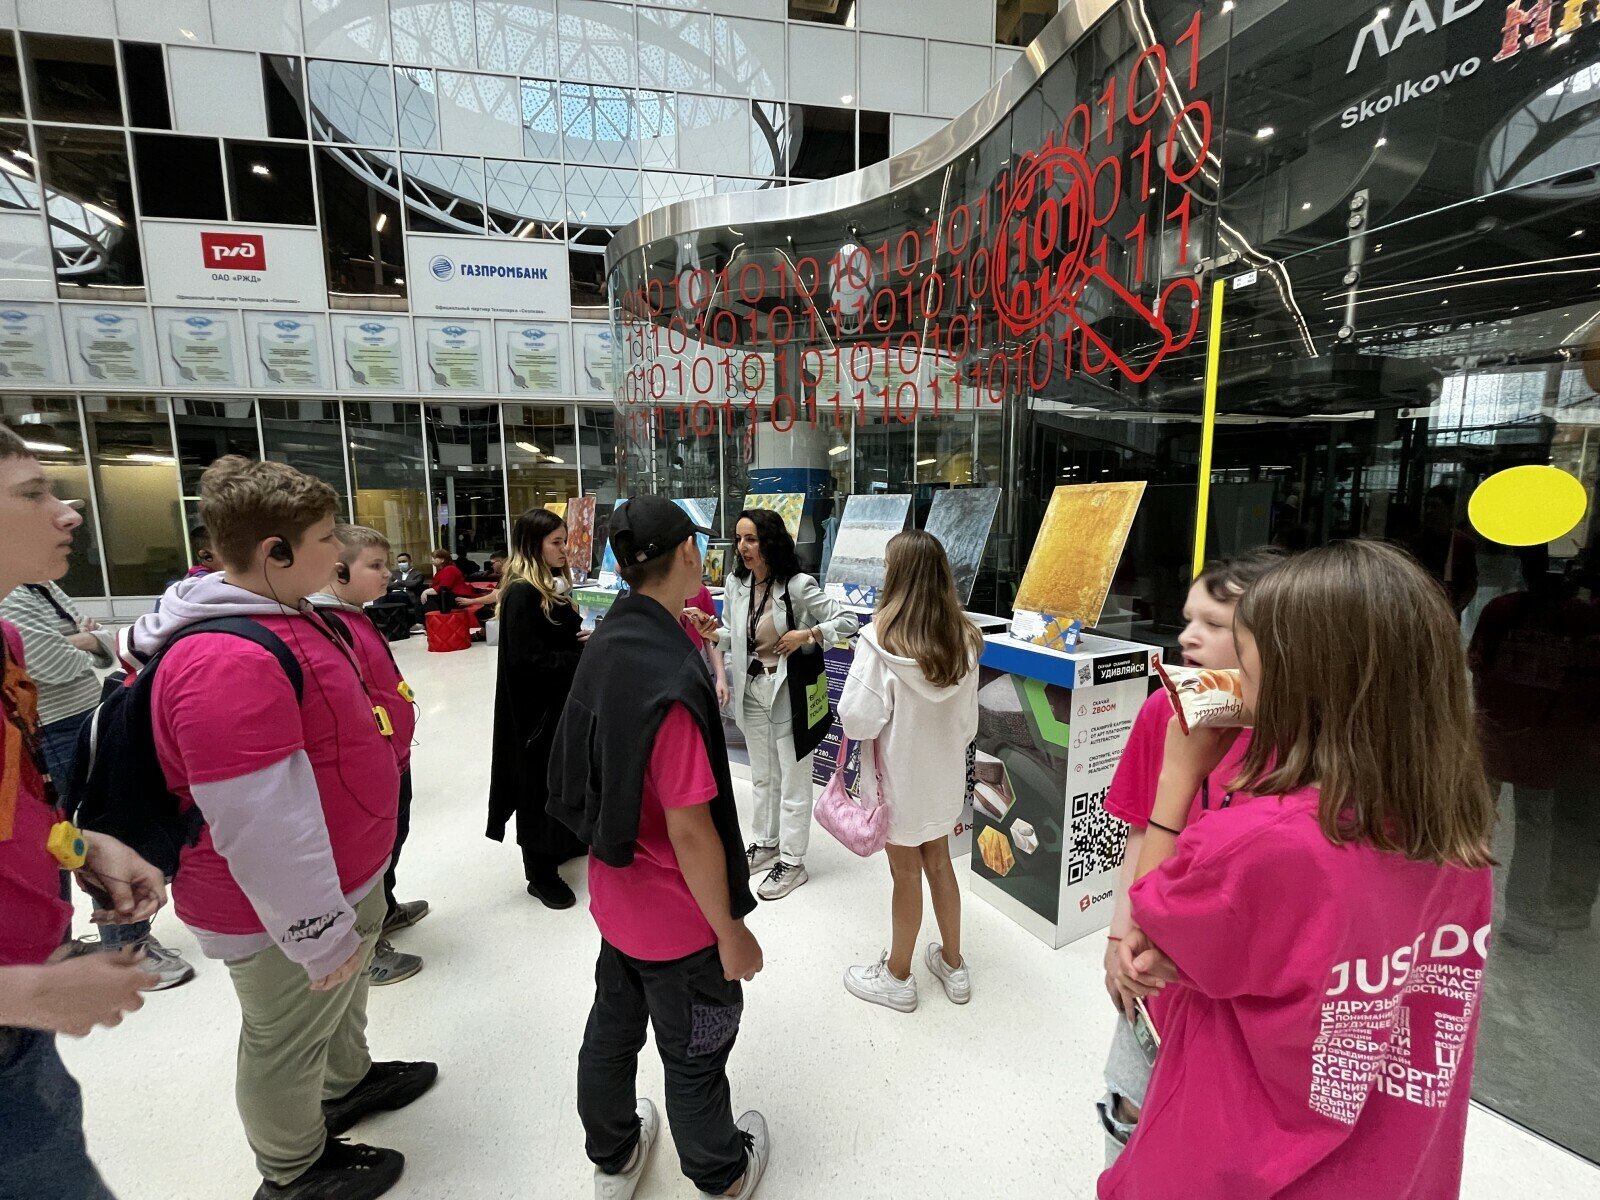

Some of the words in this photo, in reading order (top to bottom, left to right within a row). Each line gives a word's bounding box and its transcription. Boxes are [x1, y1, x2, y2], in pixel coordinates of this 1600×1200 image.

[1340, 56, 1481, 129] Skolkovo
[211, 273, 230, 282] ОАО
[232, 275, 262, 283] «РЖД»
[460, 264, 549, 280] ГАЗПРОМБАНК
[1100, 663, 1146, 680] УДИВЛЯЙСЯ
[1092, 698, 1110, 706] СКАЧАЙ
[1092, 703, 1116, 715] ZBOOM
[1090, 722, 1113, 733] СКАНИРУЙ
[1087, 763, 1115, 775] РЕАЛЬНОСТИ
[1091, 889, 1113, 904] boom
[1335, 1019, 1392, 1030] БУДУЩЕЕ
[1328, 1037, 1387, 1053] ДОБРО
[1312, 1075, 1368, 1093] ЗНАНИЯ
[1311, 1083, 1366, 1102] РЕВЬЮ
